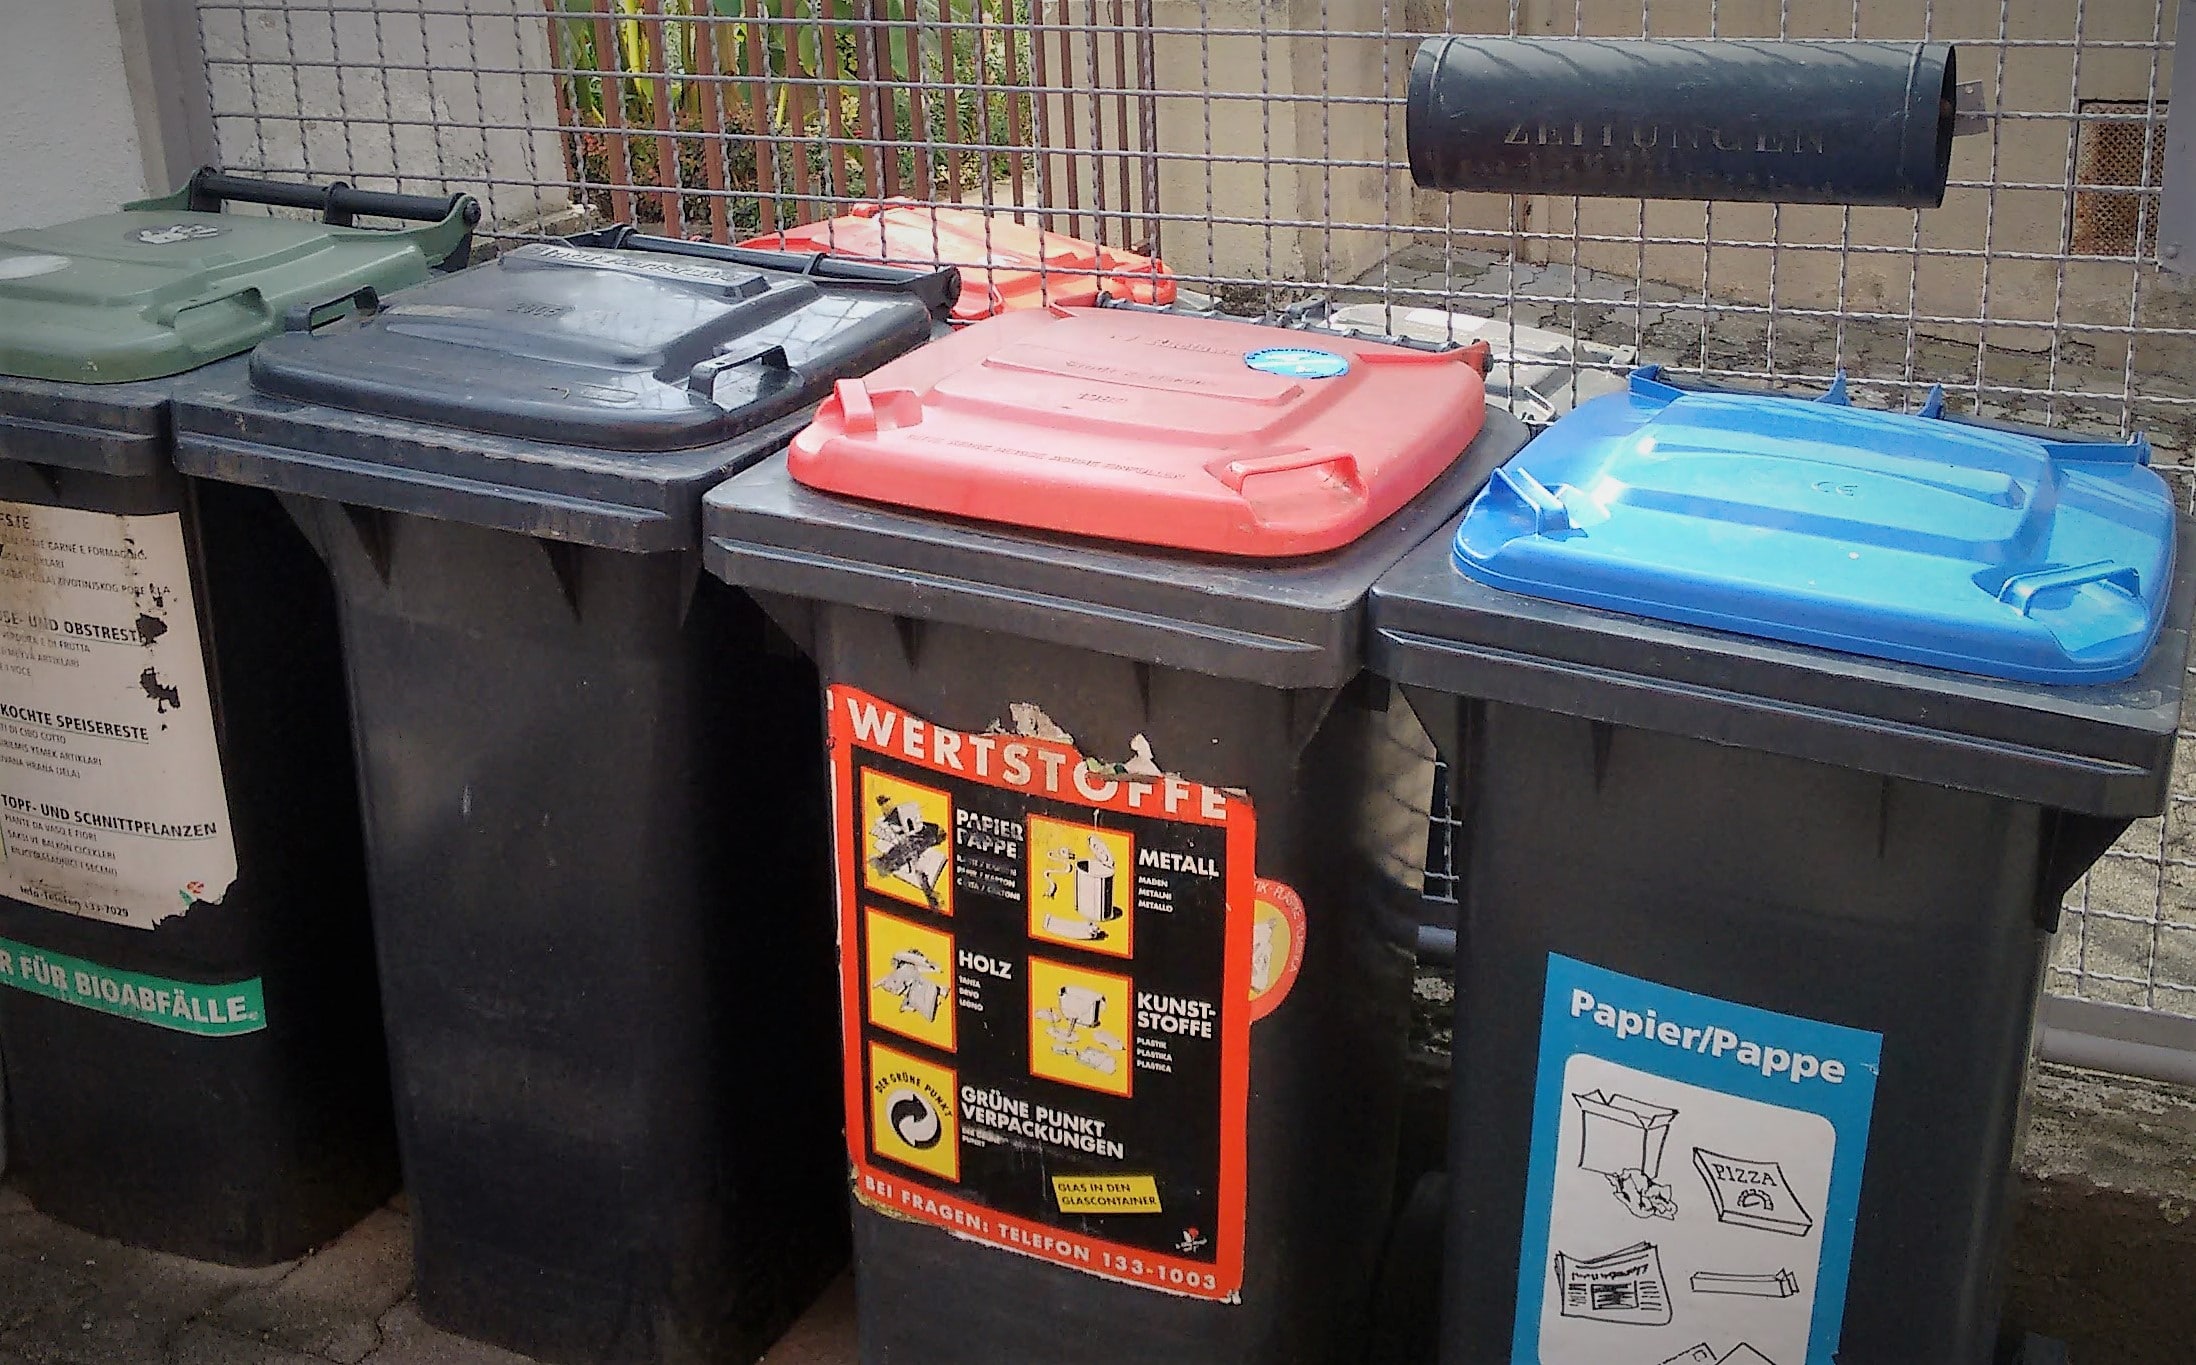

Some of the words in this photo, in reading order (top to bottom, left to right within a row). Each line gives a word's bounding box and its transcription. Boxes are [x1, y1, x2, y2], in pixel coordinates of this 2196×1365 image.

[56, 714, 150, 742] SPEISERESTE
[846, 697, 1227, 822] WERTSTOFFE
[0, 793, 37, 813] TOPF-
[40, 803, 70, 821] UND
[74, 809, 218, 839] SCHNITTPFLANZEN
[956, 807, 1025, 843] PAPIER
[1138, 848, 1220, 878] METALL
[1137, 876, 1169, 888] MADEN
[1137, 899, 1174, 913] METALLO
[19, 955, 69, 991] FÜR
[958, 949, 1012, 980] HOLZ
[1136, 991, 1217, 1020] KUNST-
[1136, 1010, 1212, 1040] STOFFE
[1568, 987, 1847, 1085] Papier/Pappe
[874, 1077, 889, 1094] DER
[889, 1071, 921, 1087] GRÜNE
[924, 1083, 953, 1117] PUNKT
[961, 1085, 1030, 1117] GRÜNE
[1035, 1105, 1106, 1138] PUNKT
[961, 1102, 1124, 1160] VERPACKUNGEN
[1057, 1183, 1088, 1193] GLAS
[1089, 1183, 1104, 1193] IN
[1106, 1183, 1131, 1193] DEN
[1711, 1162, 1779, 1188] PIZZA
[1061, 1196, 1157, 1206] GLASCONTAINER
[865, 1175, 893, 1199] BEI
[901, 1189, 990, 1234] FRAGEN:
[998, 1222, 1091, 1262] TELEFON
[1102, 1251, 1217, 1291] 133-1003
